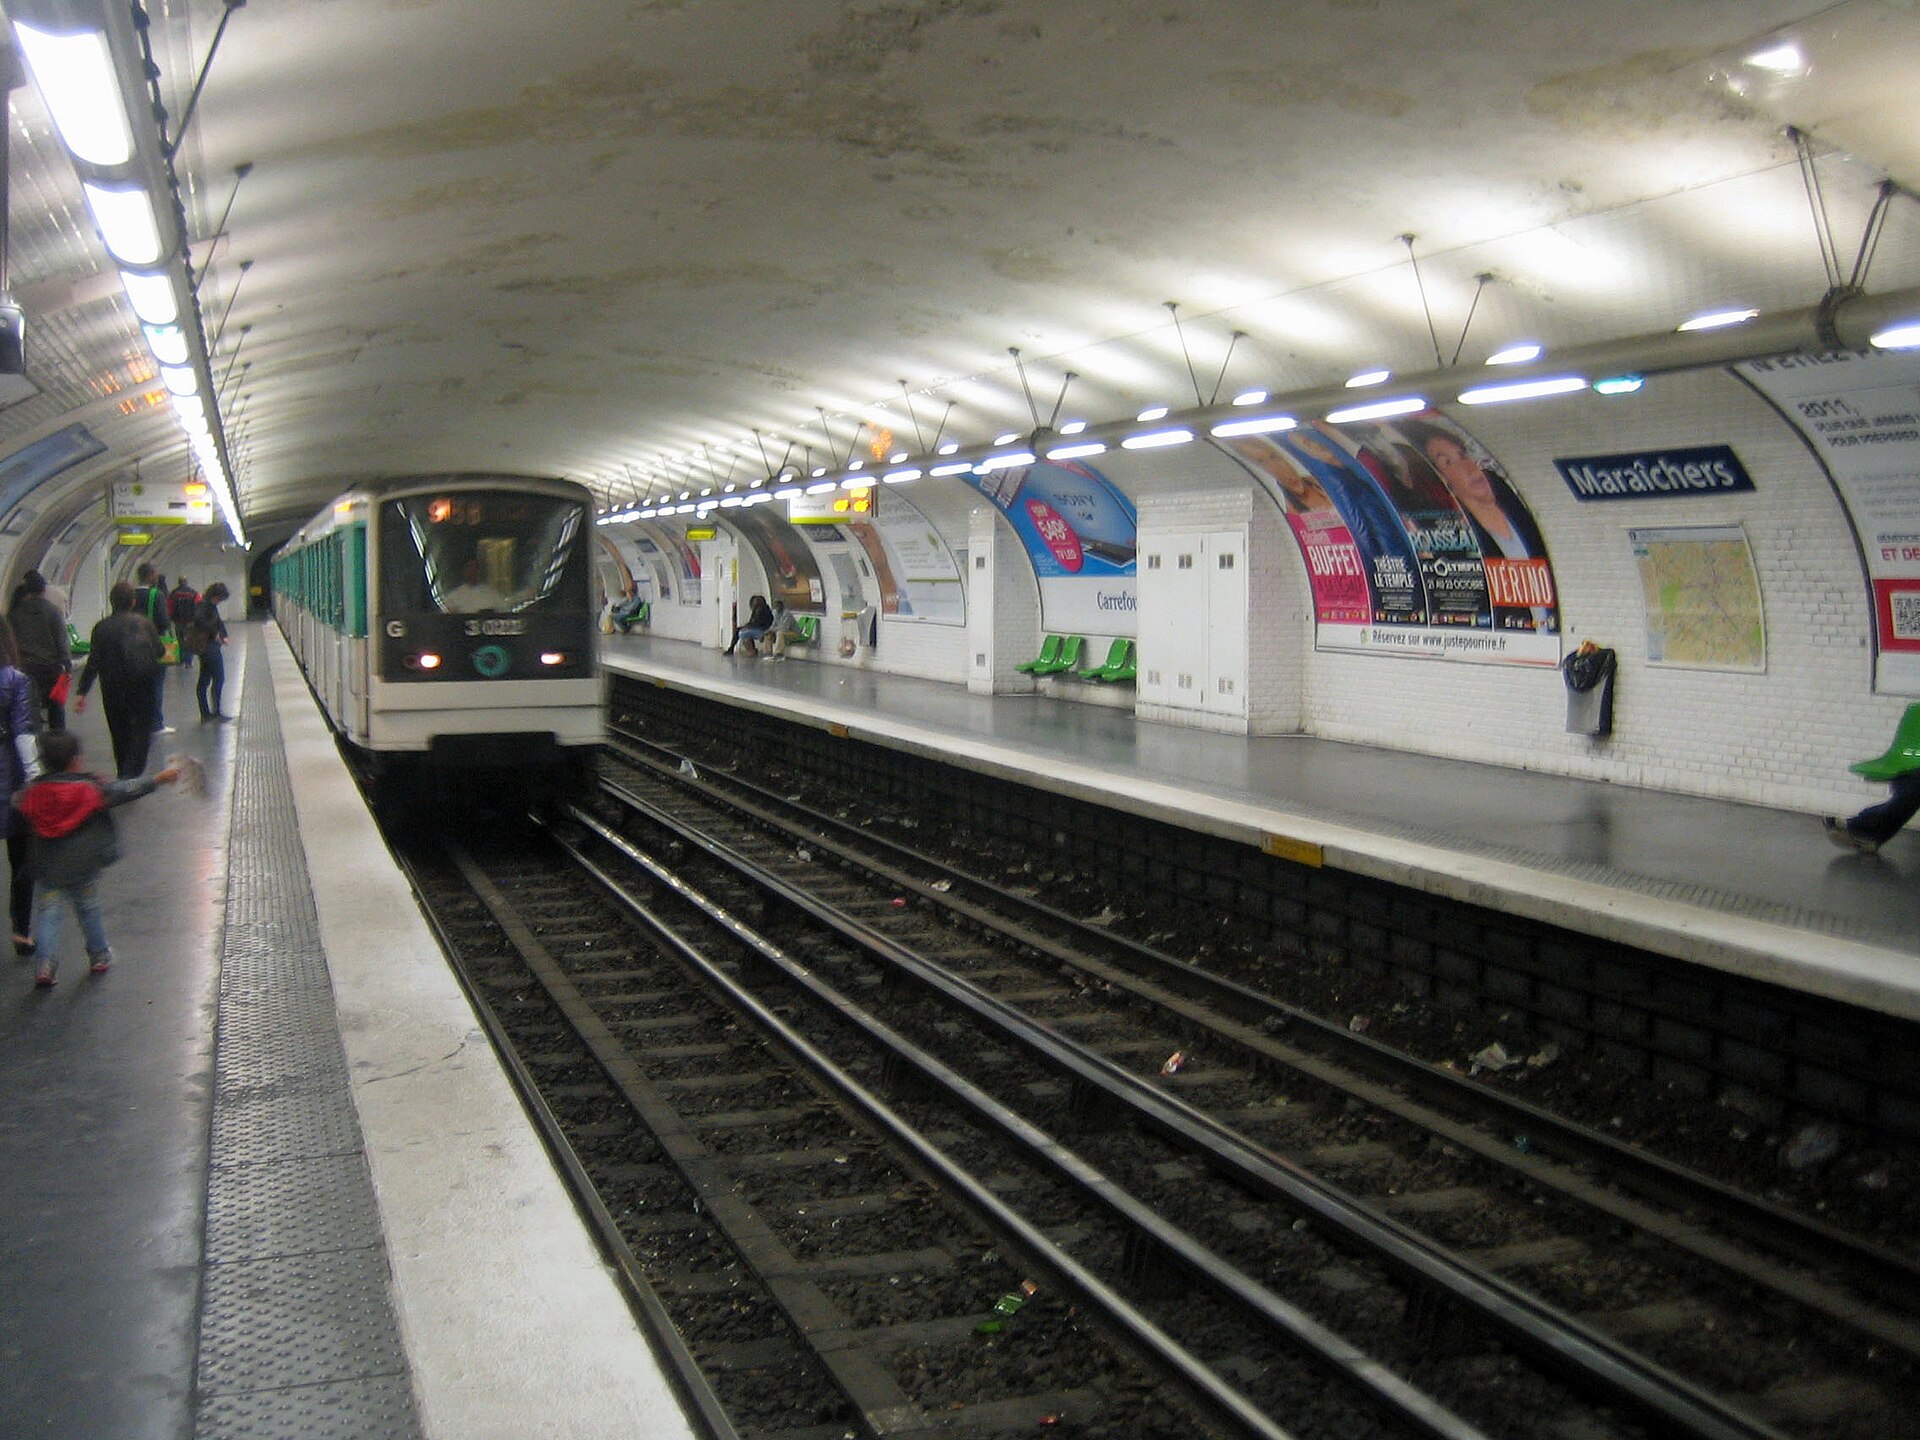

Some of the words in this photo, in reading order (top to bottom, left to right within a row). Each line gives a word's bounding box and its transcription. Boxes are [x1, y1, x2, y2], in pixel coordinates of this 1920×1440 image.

[1568, 458, 1735, 495] Maraîchers
[1306, 545, 1360, 576] BUFFET
[1486, 561, 1552, 604] VÉRINO
[386, 620, 405, 637] G
[1372, 629, 1405, 645] Réservez
[1408, 635, 1420, 645] sur
